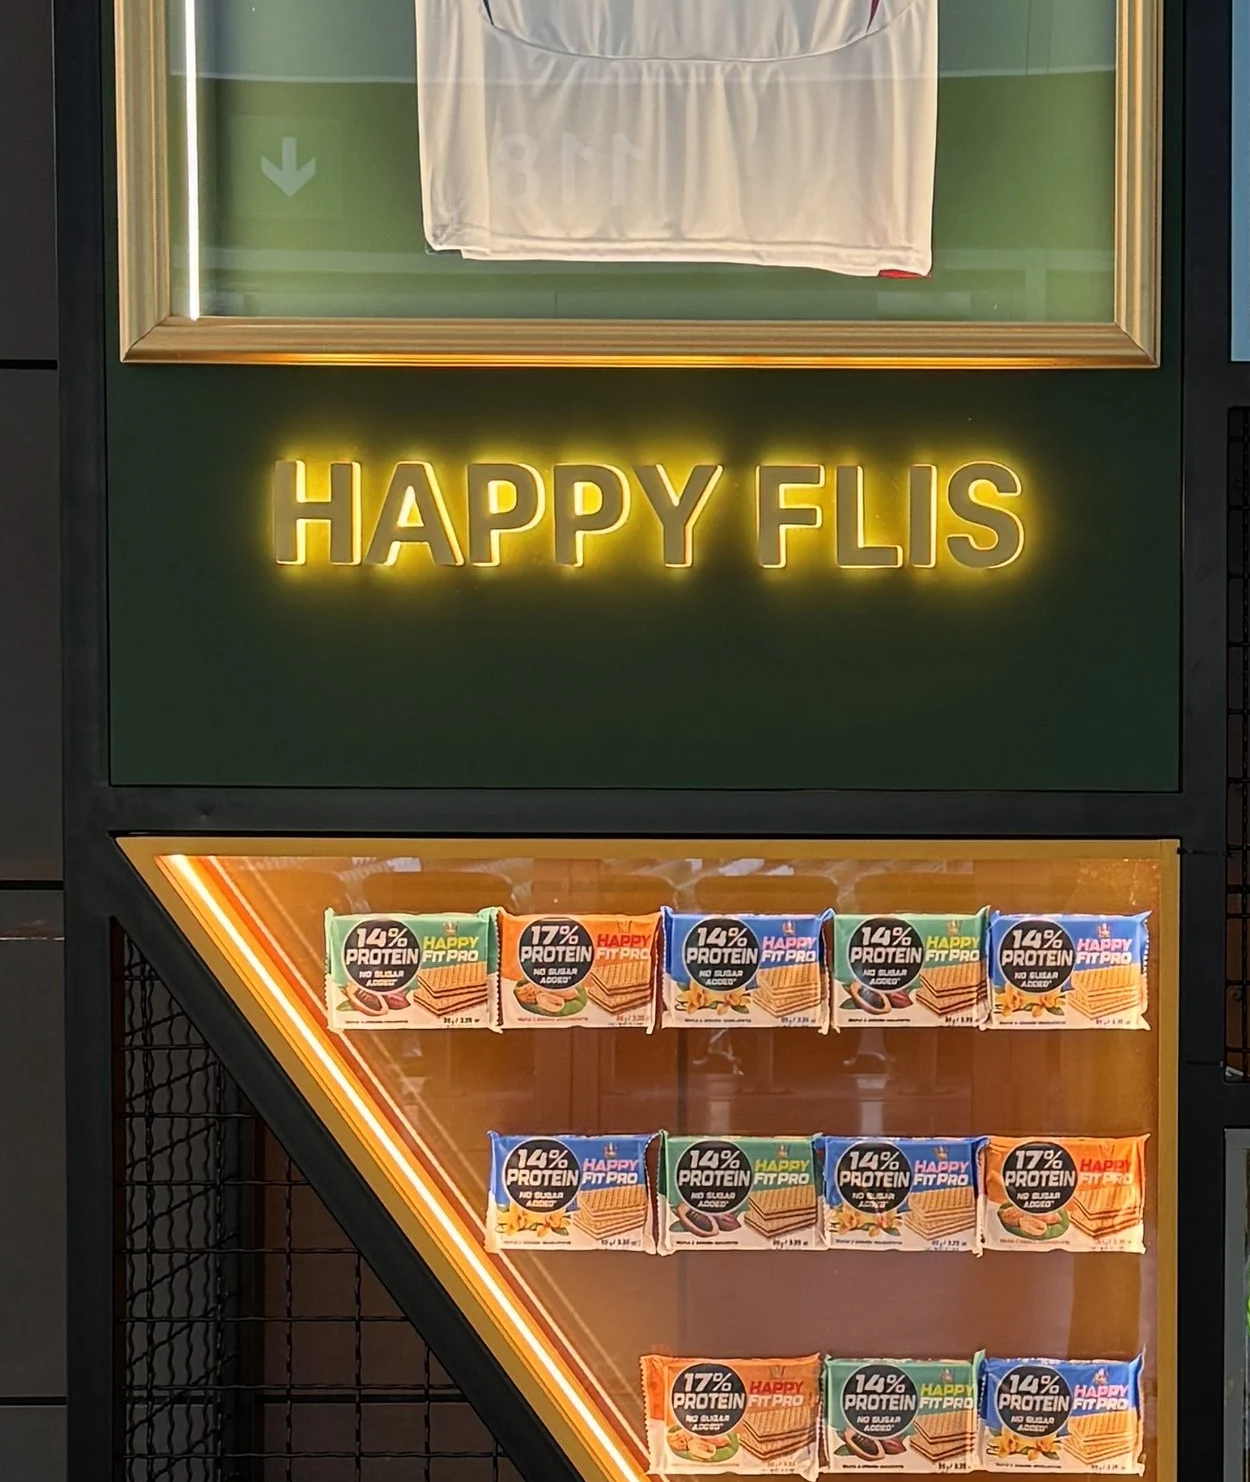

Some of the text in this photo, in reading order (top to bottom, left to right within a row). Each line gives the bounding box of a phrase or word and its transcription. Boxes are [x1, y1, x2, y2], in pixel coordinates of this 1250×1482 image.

[274, 459, 1025, 568] HAPPY FLIS
[356, 928, 408, 947] 14%
[423, 937, 479, 950] HAPPY
[531, 925, 578, 945] 17%
[597, 933, 650, 948] HAPPY
[697, 926, 748, 947] 14%
[861, 926, 912, 947] 14%
[927, 936, 980, 950] HAPPY
[1012, 930, 1062, 949] 14%
[763, 937, 817, 951] HAPPY
[1077, 938, 1132, 951] HAPPY
[346, 949, 418, 965] PROTEIN
[521, 946, 592, 962] PROTEIN
[687, 947, 758, 965] PROTEIN
[851, 947, 922, 965] PROTEIN
[1002, 951, 1073, 966] PROTEIN
[517, 1149, 568, 1170] 14%
[583, 1158, 639, 1173] HAPPY
[689, 1149, 740, 1170] 14%
[755, 1159, 810, 1173] HAPPY
[849, 1150, 900, 1171] 14%
[914, 1160, 969, 1174] HAPPY
[1015, 1149, 1061, 1169] 17%
[1081, 1158, 1133, 1172] HAPPY
[507, 1170, 578, 1187] PROTEIN
[679, 1170, 750, 1187] PROTEIN
[839, 1171, 910, 1188] PROTEIN
[1005, 1170, 1075, 1187] PROTEIN
[684, 1372, 731, 1391] 17%
[749, 1380, 803, 1395] HAPPY
[855, 1373, 906, 1394] 14%
[1009, 1374, 1060, 1395] 14%
[921, 1383, 973, 1398] HAPPY
[1074, 1385, 1128, 1399] HAPPY
[674, 1393, 745, 1409] PROTEIN
[845, 1394, 916, 1412] PROTEIN
[999, 1395, 1070, 1412] PROTEIN
